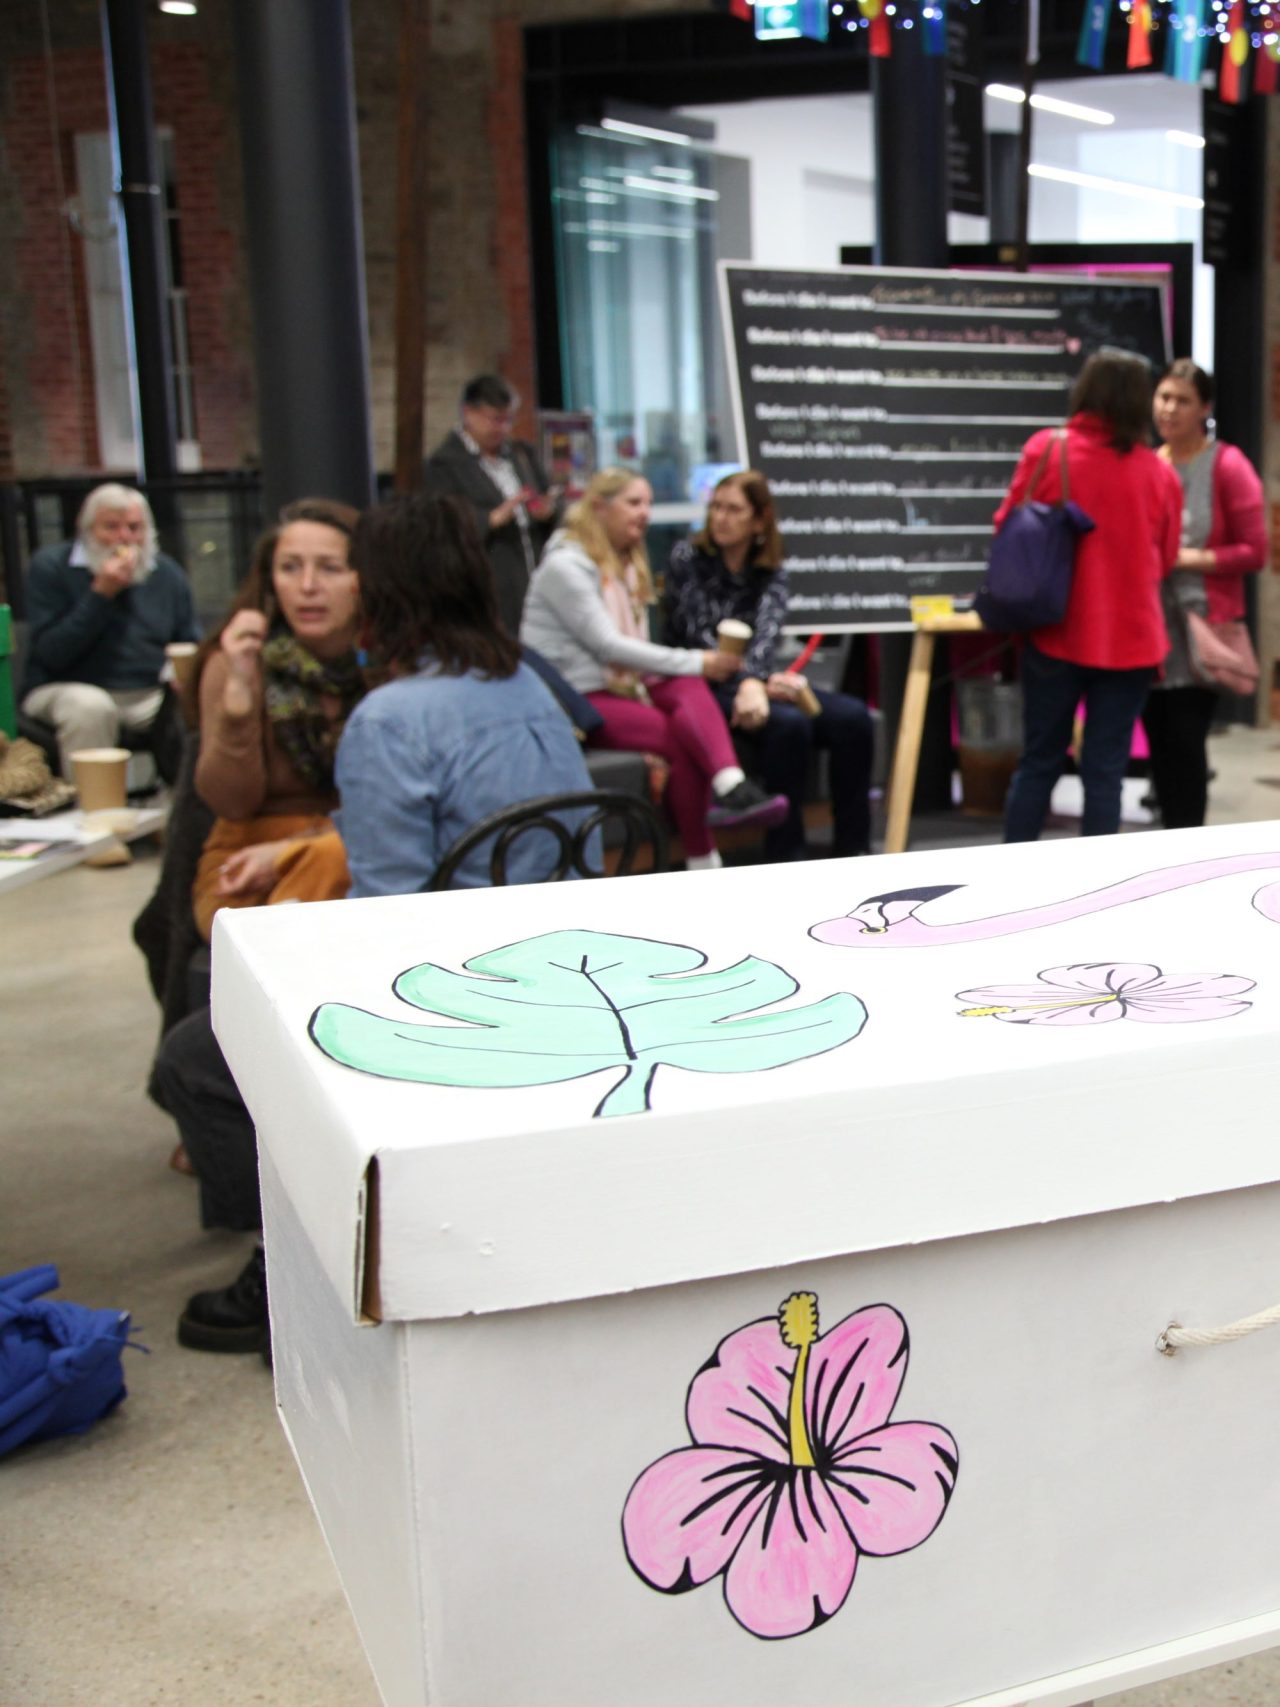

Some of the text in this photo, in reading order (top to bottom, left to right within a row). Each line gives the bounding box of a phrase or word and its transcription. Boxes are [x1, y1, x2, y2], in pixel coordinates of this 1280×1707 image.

[777, 517, 811, 534] efore
[782, 555, 815, 572] efore
[786, 594, 819, 611] efore
